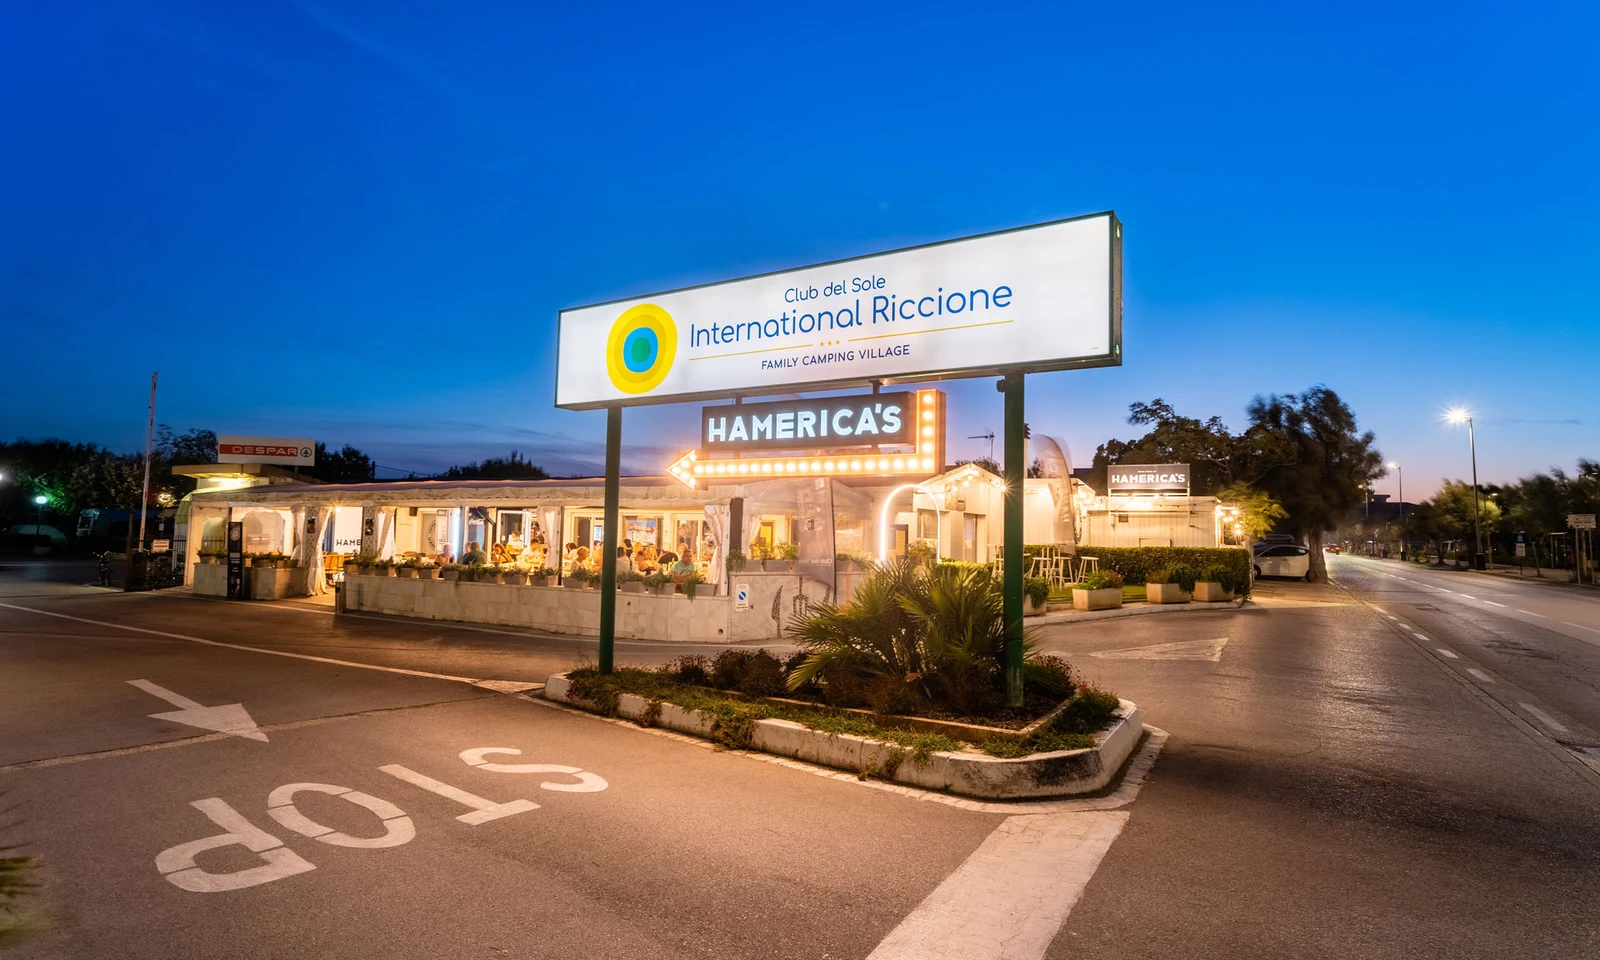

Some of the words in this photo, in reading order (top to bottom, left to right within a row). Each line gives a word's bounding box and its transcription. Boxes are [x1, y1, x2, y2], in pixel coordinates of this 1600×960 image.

[784, 286, 819, 303] Club
[823, 280, 847, 297] del
[851, 275, 886, 293] Sole
[690, 299, 863, 348] International
[872, 285, 1013, 324] Riccione
[761, 357, 799, 370] FAMILY
[802, 351, 855, 366] CAMPING
[858, 344, 911, 360] VILLAGE
[707, 403, 902, 443] HAMERICA'S
[231, 445, 297, 456] DESPAR
[1111, 473, 1186, 484] HAMERICA'S
[155, 747, 609, 893] STOP
